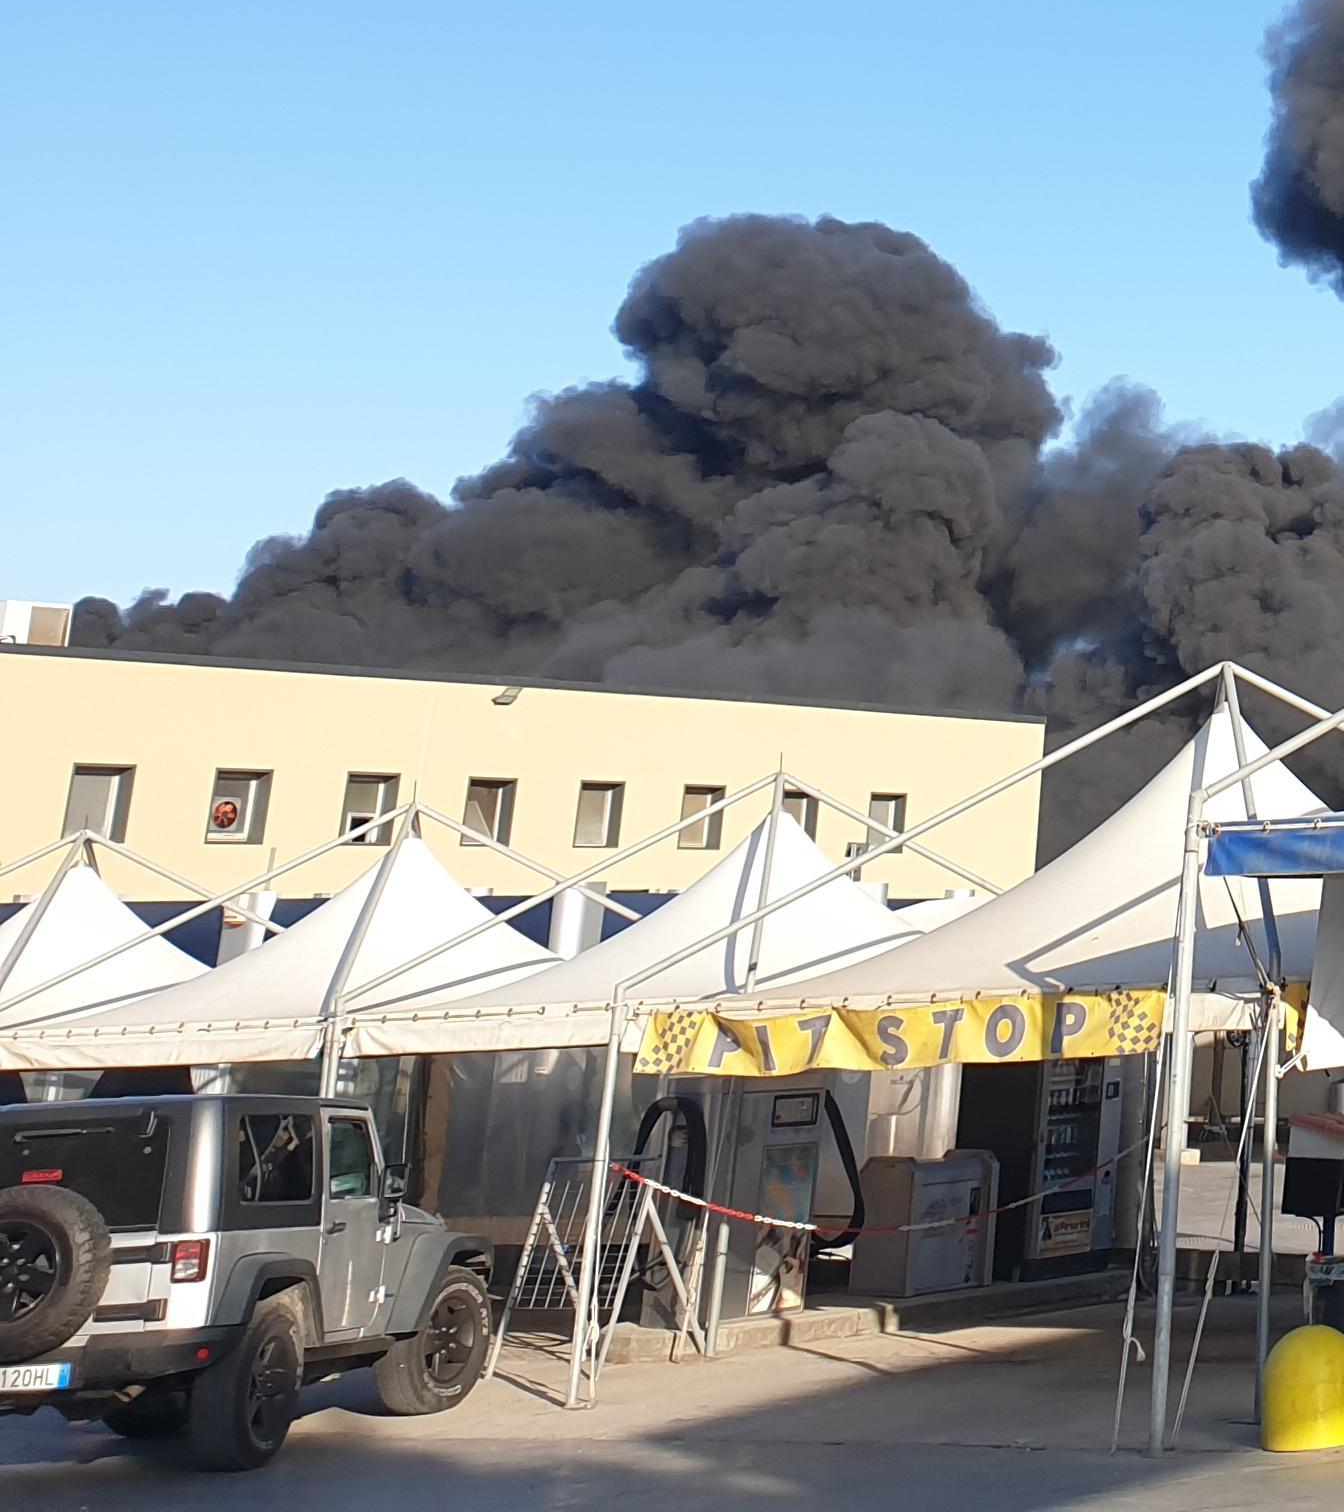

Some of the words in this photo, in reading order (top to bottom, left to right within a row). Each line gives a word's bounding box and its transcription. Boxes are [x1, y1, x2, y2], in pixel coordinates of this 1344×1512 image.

[707, 1014, 832, 1072] PIT
[876, 1001, 1086, 1067] STOP
[1, 1368, 54, 1388] 120HL
